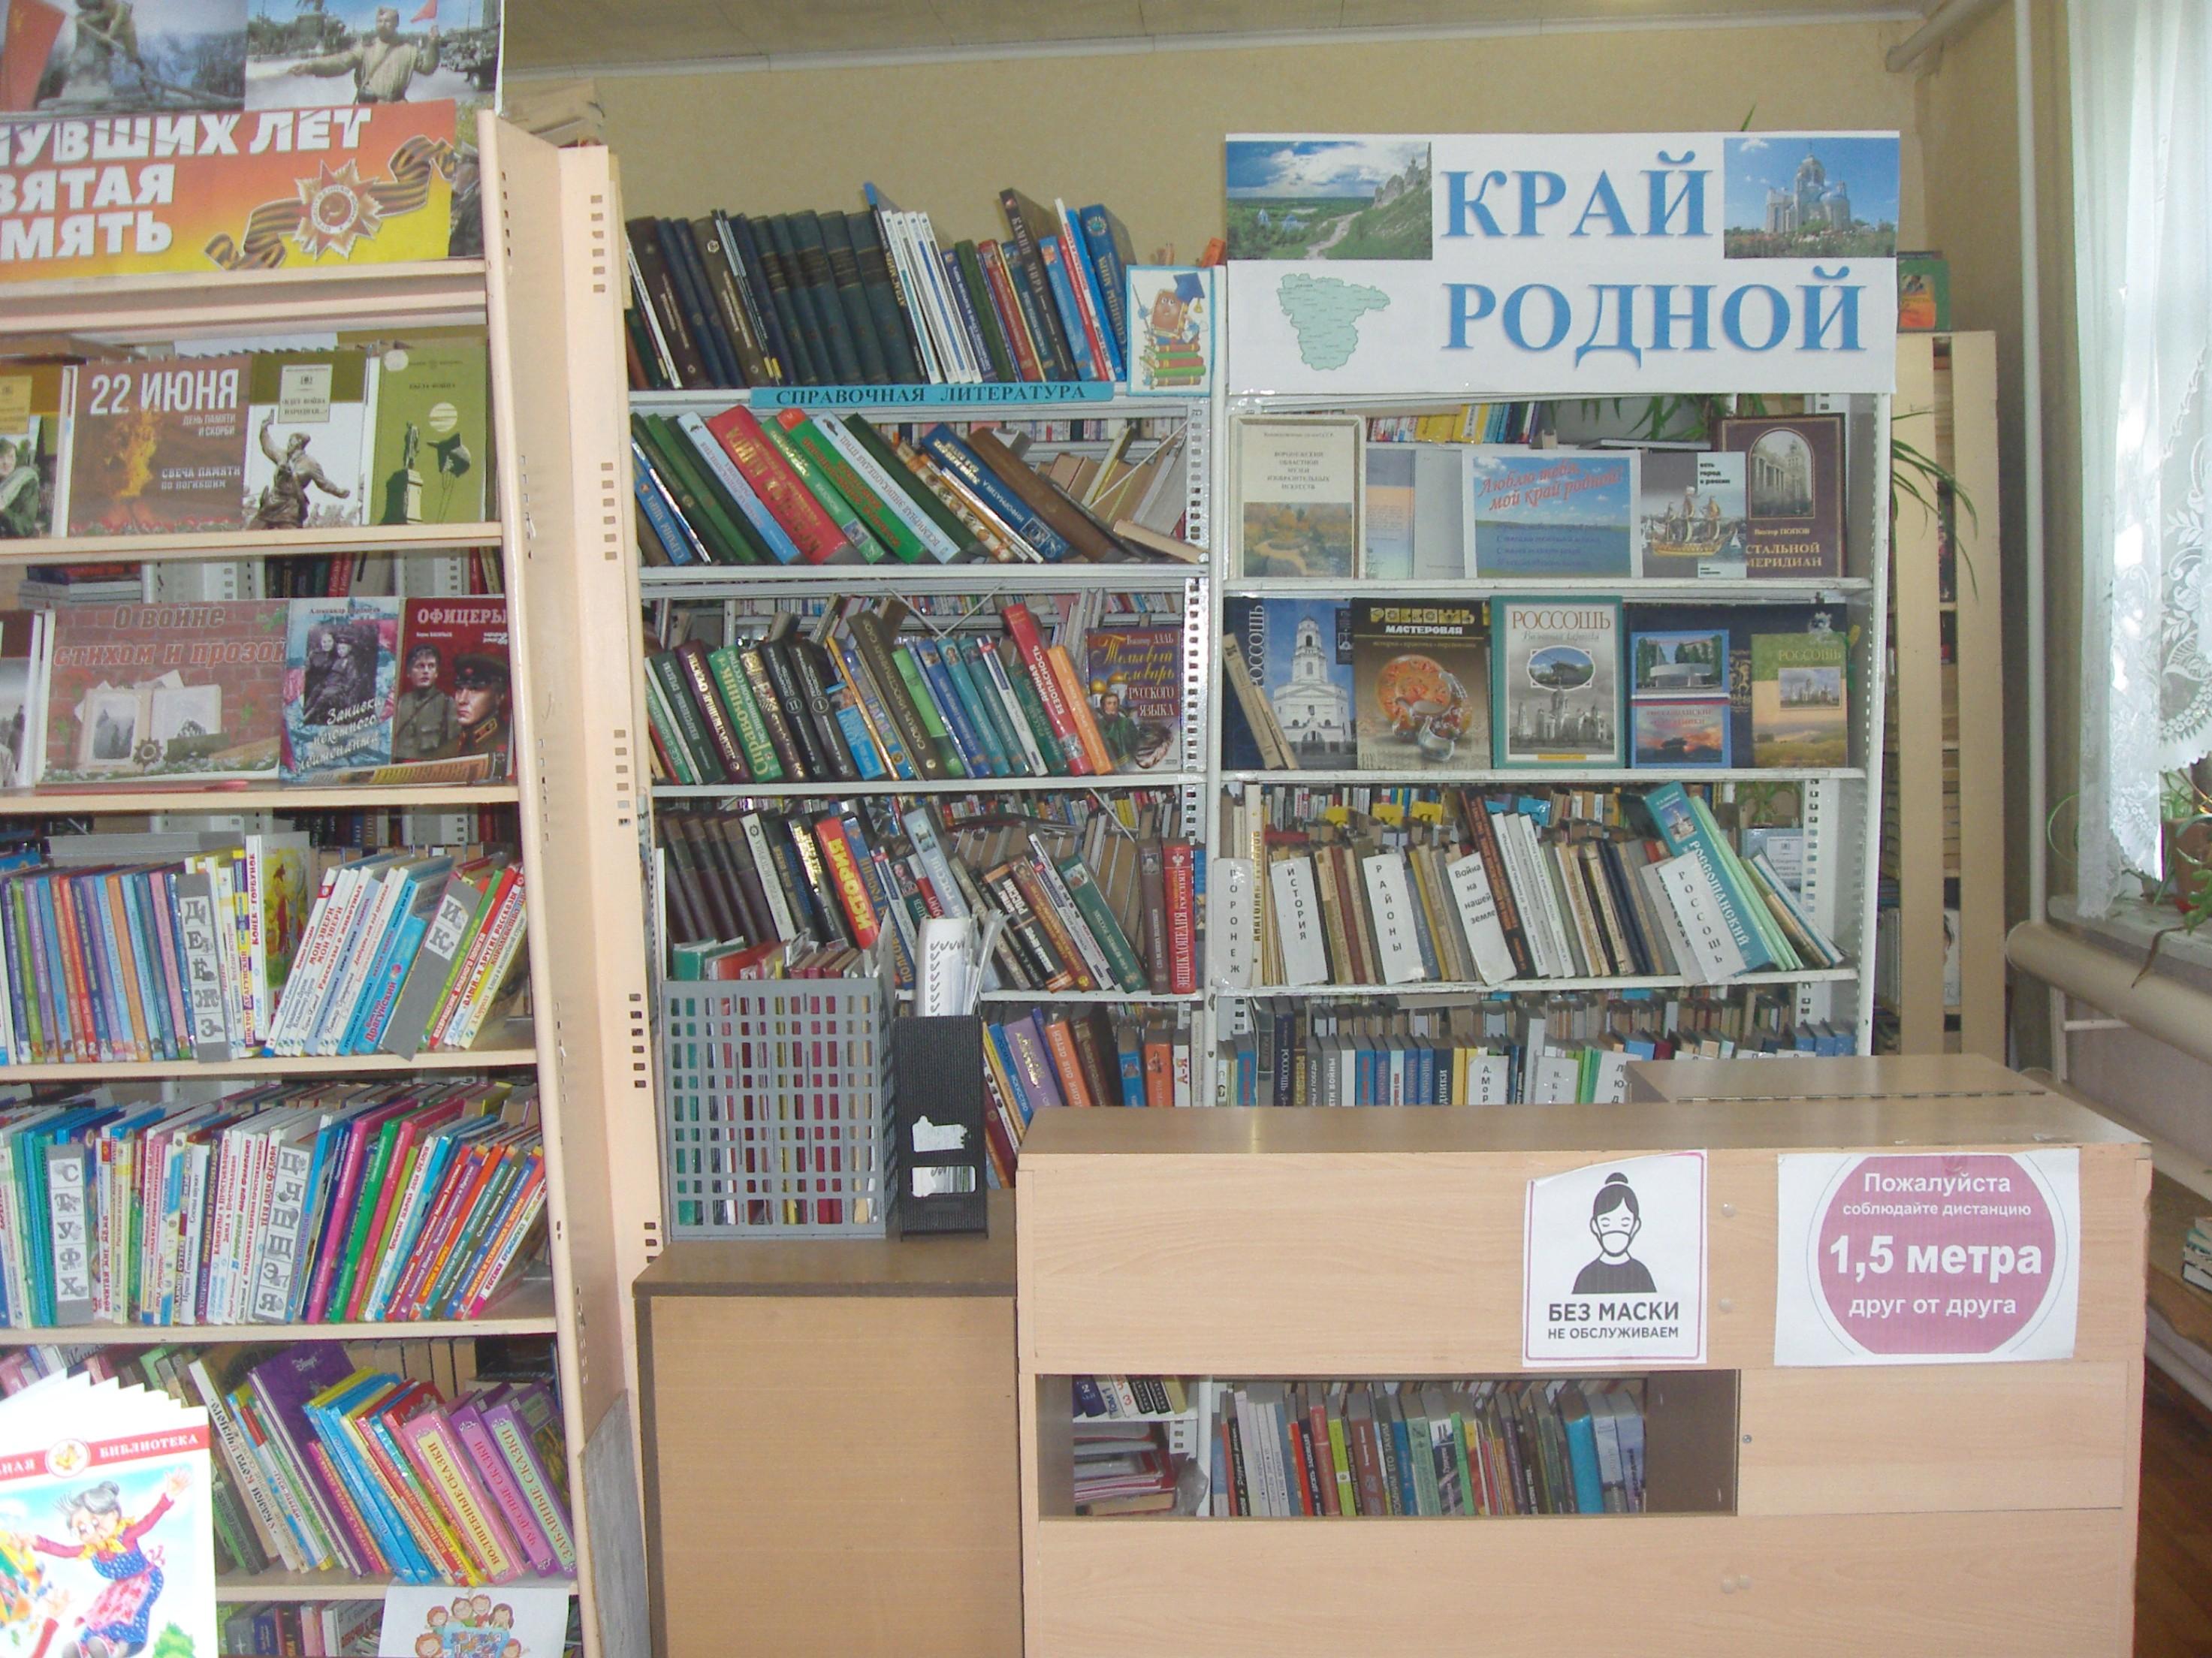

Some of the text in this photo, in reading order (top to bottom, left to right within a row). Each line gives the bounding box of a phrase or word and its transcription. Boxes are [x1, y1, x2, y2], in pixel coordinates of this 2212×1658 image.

[0, 107, 372, 167] УВШИХ ЛЕТ
[1440, 150, 1713, 239] КРАЙ
[0, 211, 173, 261] МЯТЬ
[1026, 261, 1046, 294] МИРА
[1440, 264, 1867, 370] РОДНОЙ
[90, 369, 239, 415] 22 ИЮНЯ
[776, 384, 1086, 406] СПРАВОЧНАЯ ЛИТЕРАТУРА
[204, 414, 236, 425] ПАМЯТИ
[838, 435, 941, 548] ВСЕМИРНАЯ ЭНЦИКЛОПЕДИЯ ПТИЦ
[980, 478, 1025, 524] ИНФОРМАТИКА
[1489, 490, 1521, 511] мой
[644, 494, 687, 560] СТРАНЫ МИРА
[114, 605, 131, 629] О
[1385, 625, 1463, 635] МАСТЕРОВАЯ
[1512, 610, 1610, 631] РОССОШЬ
[164, 644, 182, 665] и
[1779, 650, 1842, 662] РОССОШЬ
[1028, 663, 1050, 702] ЛИЧНАЯ
[1029, 644, 1066, 716] БЕЗОПАСНОСТЬ
[1129, 686, 1174, 698] РУССКОГО
[718, 665, 772, 776] Справочник
[902, 709, 928, 751] СЛОВАРЬ
[1139, 704, 1174, 717] ЯЗЫКА
[825, 837, 874, 930] ИСТОРИЯ
[1455, 864, 1482, 879] Война
[1466, 882, 1477, 892] на
[1002, 877, 1029, 915] РОССИИ
[1287, 868, 1307, 940] ИСТОРИЯ
[1375, 865, 1403, 952] РАЙОНЫ
[1464, 894, 1492, 911] нашей
[1470, 909, 1496, 925] земле
[1679, 870, 1723, 964] РОССОШЬ
[316, 945, 340, 990] Рассказы
[1176, 911, 1190, 989] ЭНЦИКЛОПЕДИЯ
[243, 1010, 253, 1044] ВИКТОР
[1863, 1172, 2011, 1196] Пожалуйста
[1842, 1202, 2032, 1218] соблюдайте дистанцию
[243, 1237, 253, 1276] ПРАЗДНИКИ
[249, 1201, 257, 1228] ДЕРЕВНЕ
[1829, 1235, 2042, 1282] 1,5 метра
[1548, 1301, 1679, 1323] БЕЗ МАСКИ
[1848, 1296, 2017, 1318] друг от друга
[1547, 1325, 1679, 1340] НЕ ОБСЛУЖИВАЕМ
[99, 1433, 199, 1458] БИБЛИОТЕКА
[474, 1440, 504, 1485] СКАЗКИ
[427, 1441, 460, 1491] СКАЗКИ
[502, 1428, 572, 1559] ЗАБАВНЫЕ СКАЗКИ
[459, 1491, 501, 1566] ВОЛШЕБНЫЕ
